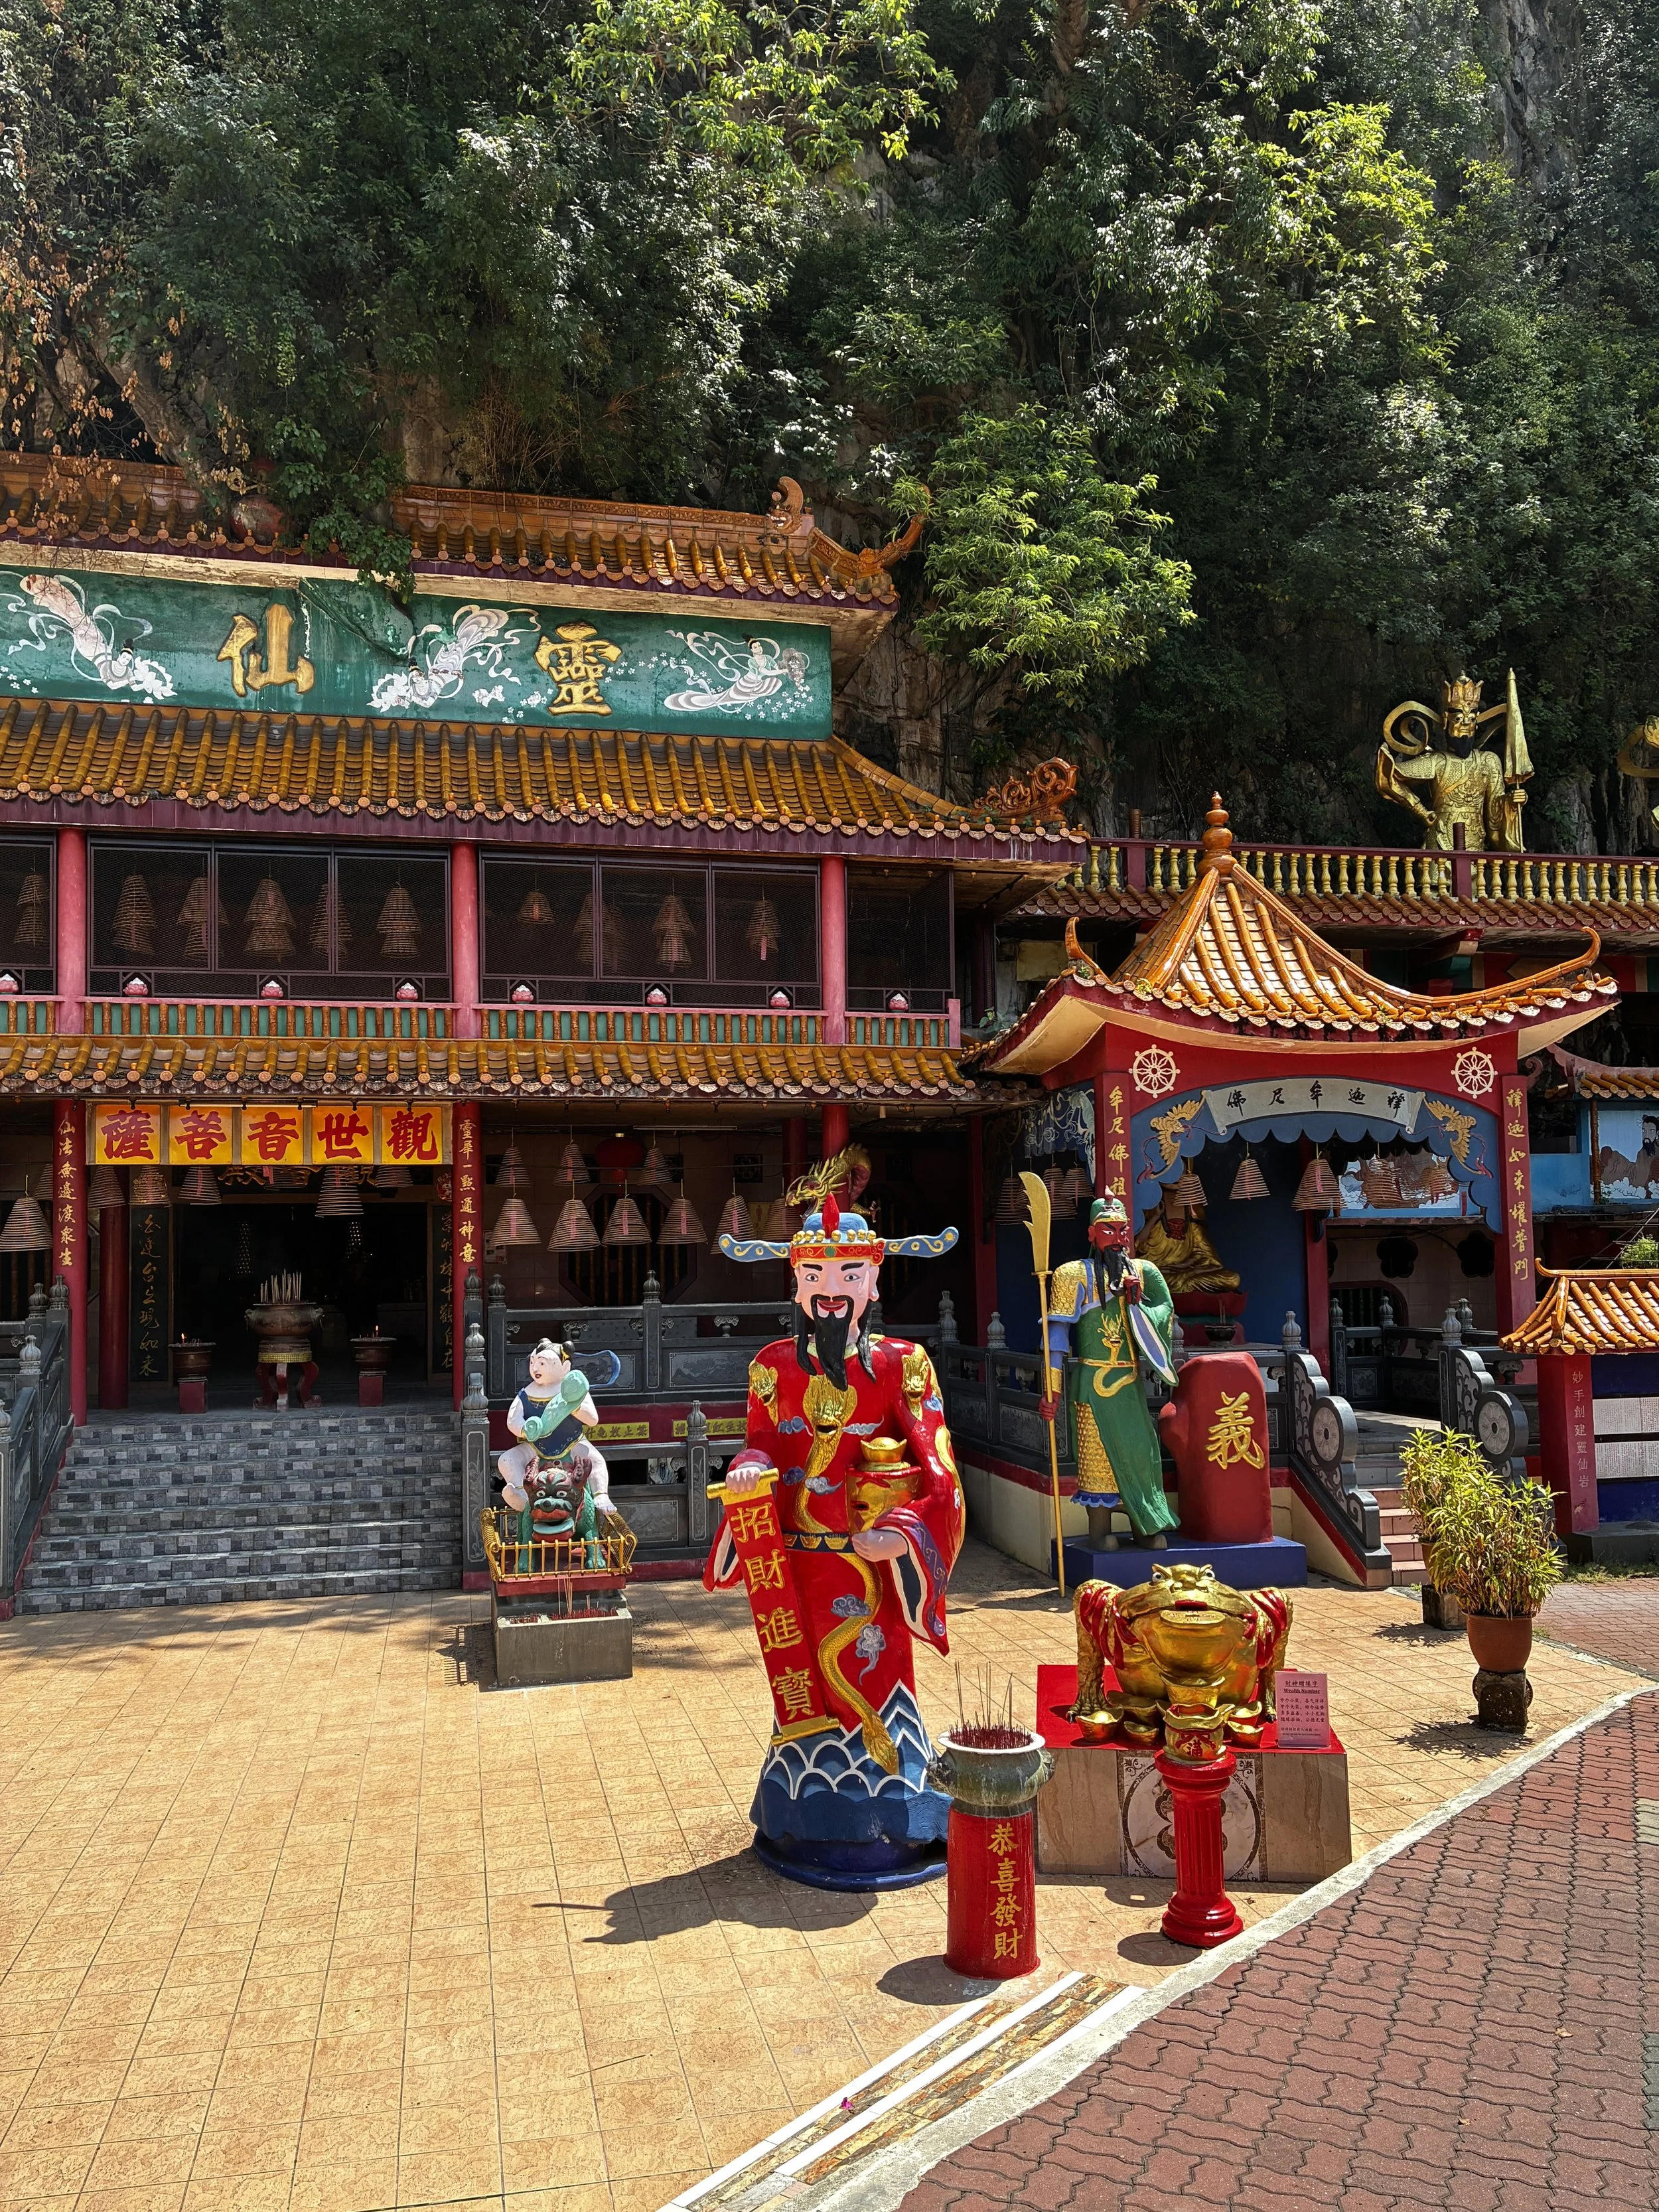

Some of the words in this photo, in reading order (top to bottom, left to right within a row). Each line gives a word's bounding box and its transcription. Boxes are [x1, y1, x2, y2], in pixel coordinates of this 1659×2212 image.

[218, 604, 315, 697] 仙
[535, 622, 622, 715] 靈
[101, 1109, 439, 1160] 觀世音菩薩
[1205, 1391, 1265, 1469] 義
[730, 1502, 815, 1720] 招財進寶
[987, 1822, 1023, 1960] 恭喜發財
